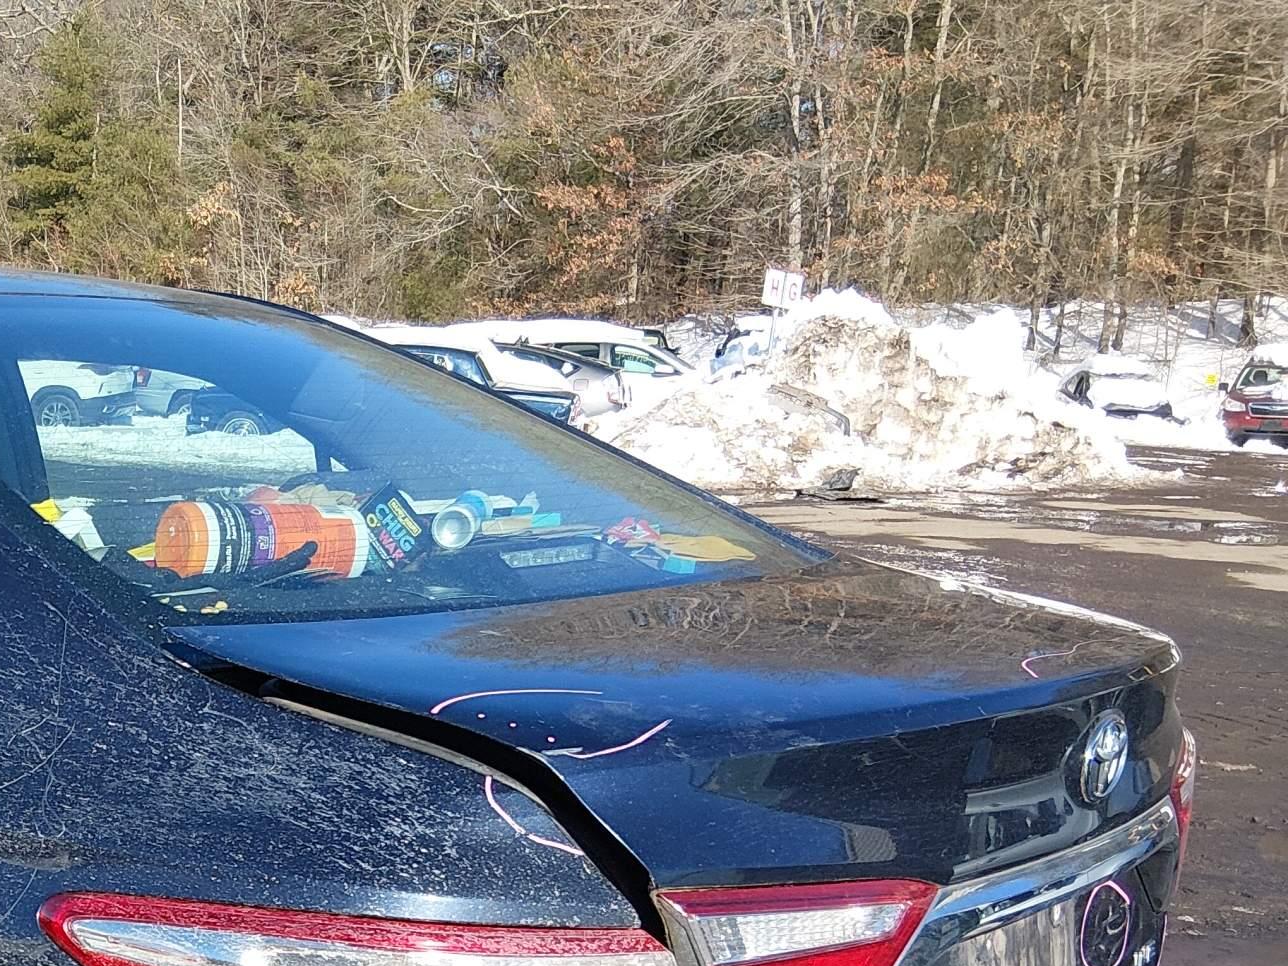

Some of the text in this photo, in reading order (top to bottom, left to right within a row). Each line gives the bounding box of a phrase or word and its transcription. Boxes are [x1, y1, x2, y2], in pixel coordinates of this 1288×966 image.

[770, 279, 780, 297] H
[788, 282, 798, 301] G
[375, 503, 415, 552] CHUG
[379, 529, 406, 561] WAR
